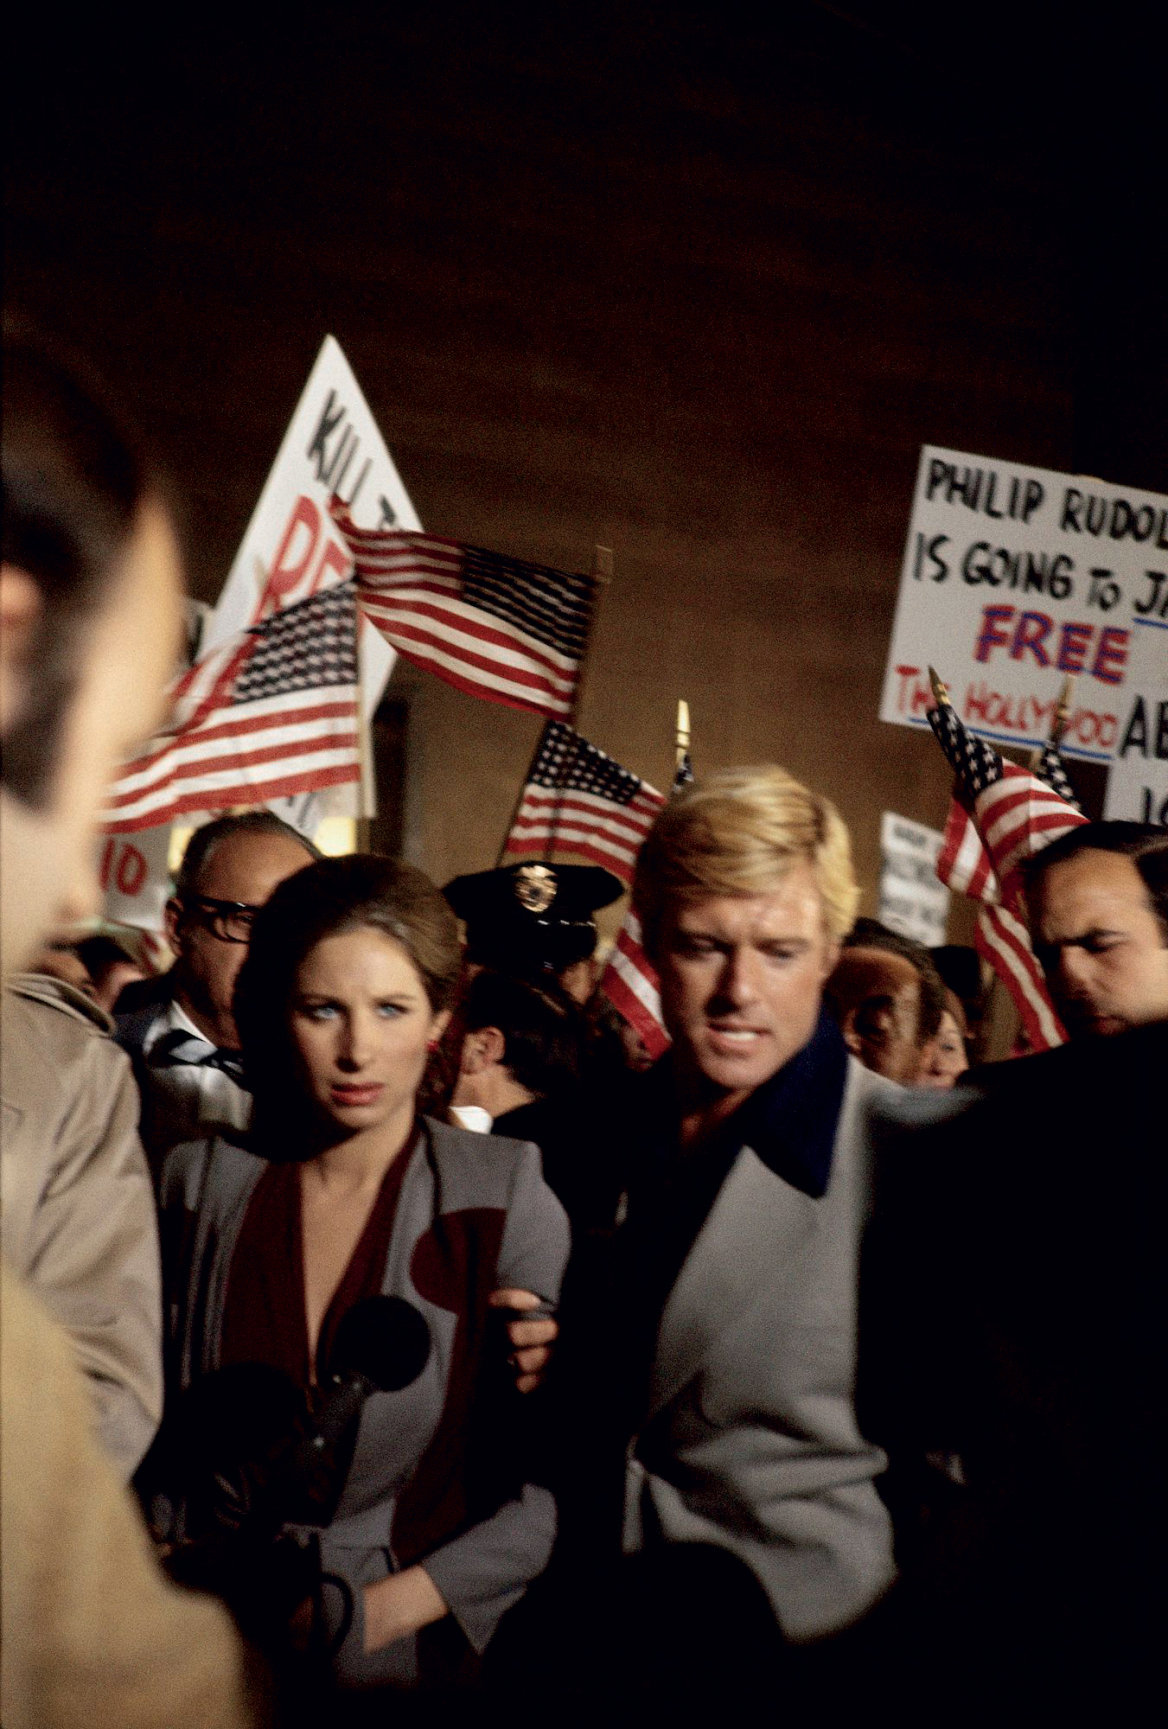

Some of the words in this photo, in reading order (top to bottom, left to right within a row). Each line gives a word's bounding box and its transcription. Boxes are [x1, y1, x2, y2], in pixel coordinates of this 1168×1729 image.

[926, 458, 1045, 524] PHILIP
[913, 532, 949, 584] IS
[962, 541, 1074, 599] GOING
[974, 604, 1131, 686] FREE
